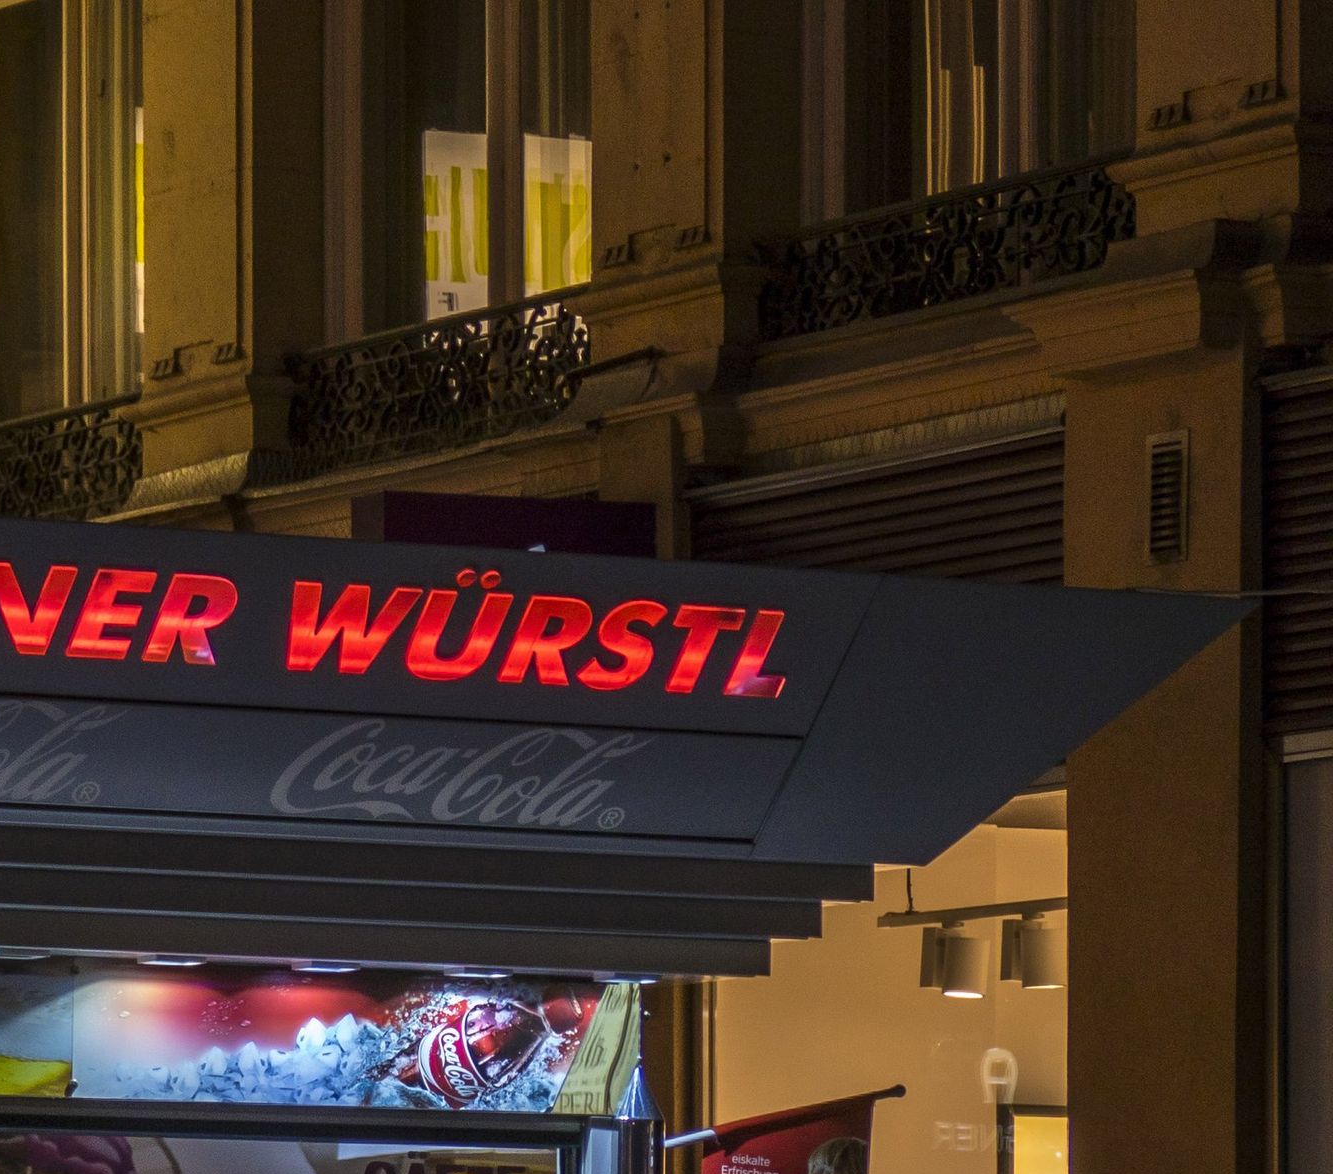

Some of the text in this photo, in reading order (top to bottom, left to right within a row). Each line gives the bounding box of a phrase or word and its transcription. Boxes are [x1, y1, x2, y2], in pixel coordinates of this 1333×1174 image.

[284, 569, 786, 699] WÜRSTL
[270, 718, 653, 827] Coca-Cola
[731, 1154, 771, 1167] eiskalte
